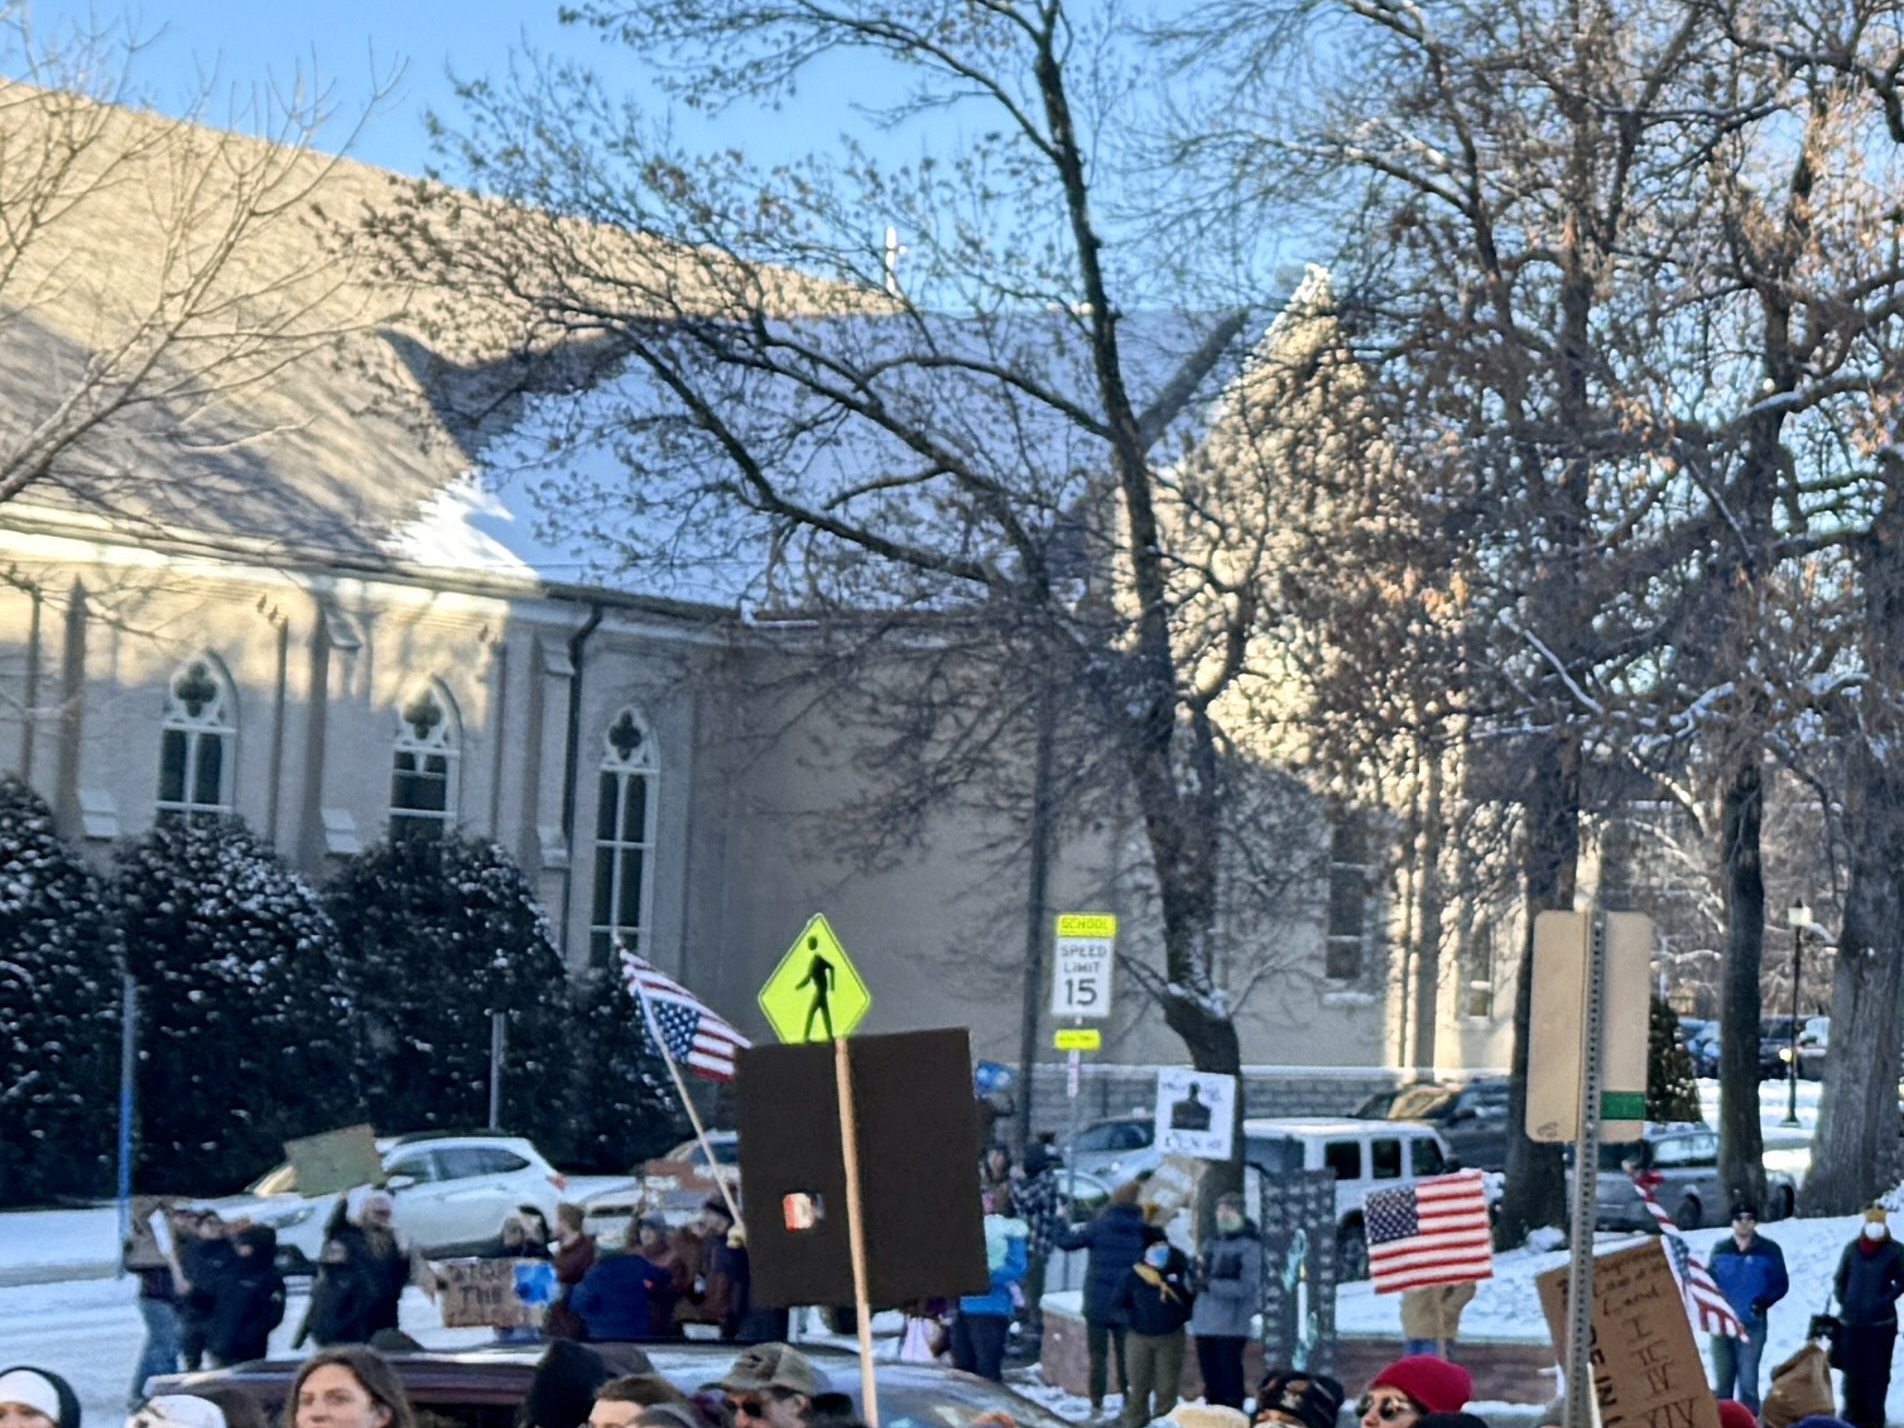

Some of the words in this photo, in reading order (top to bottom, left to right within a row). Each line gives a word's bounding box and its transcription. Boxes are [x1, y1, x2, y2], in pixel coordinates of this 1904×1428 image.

[1060, 916, 1110, 930] SCHOOL
[1060, 945, 1107, 957] SPEED
[1063, 962, 1101, 973] LIMIT
[1065, 978, 1098, 1006] 15
